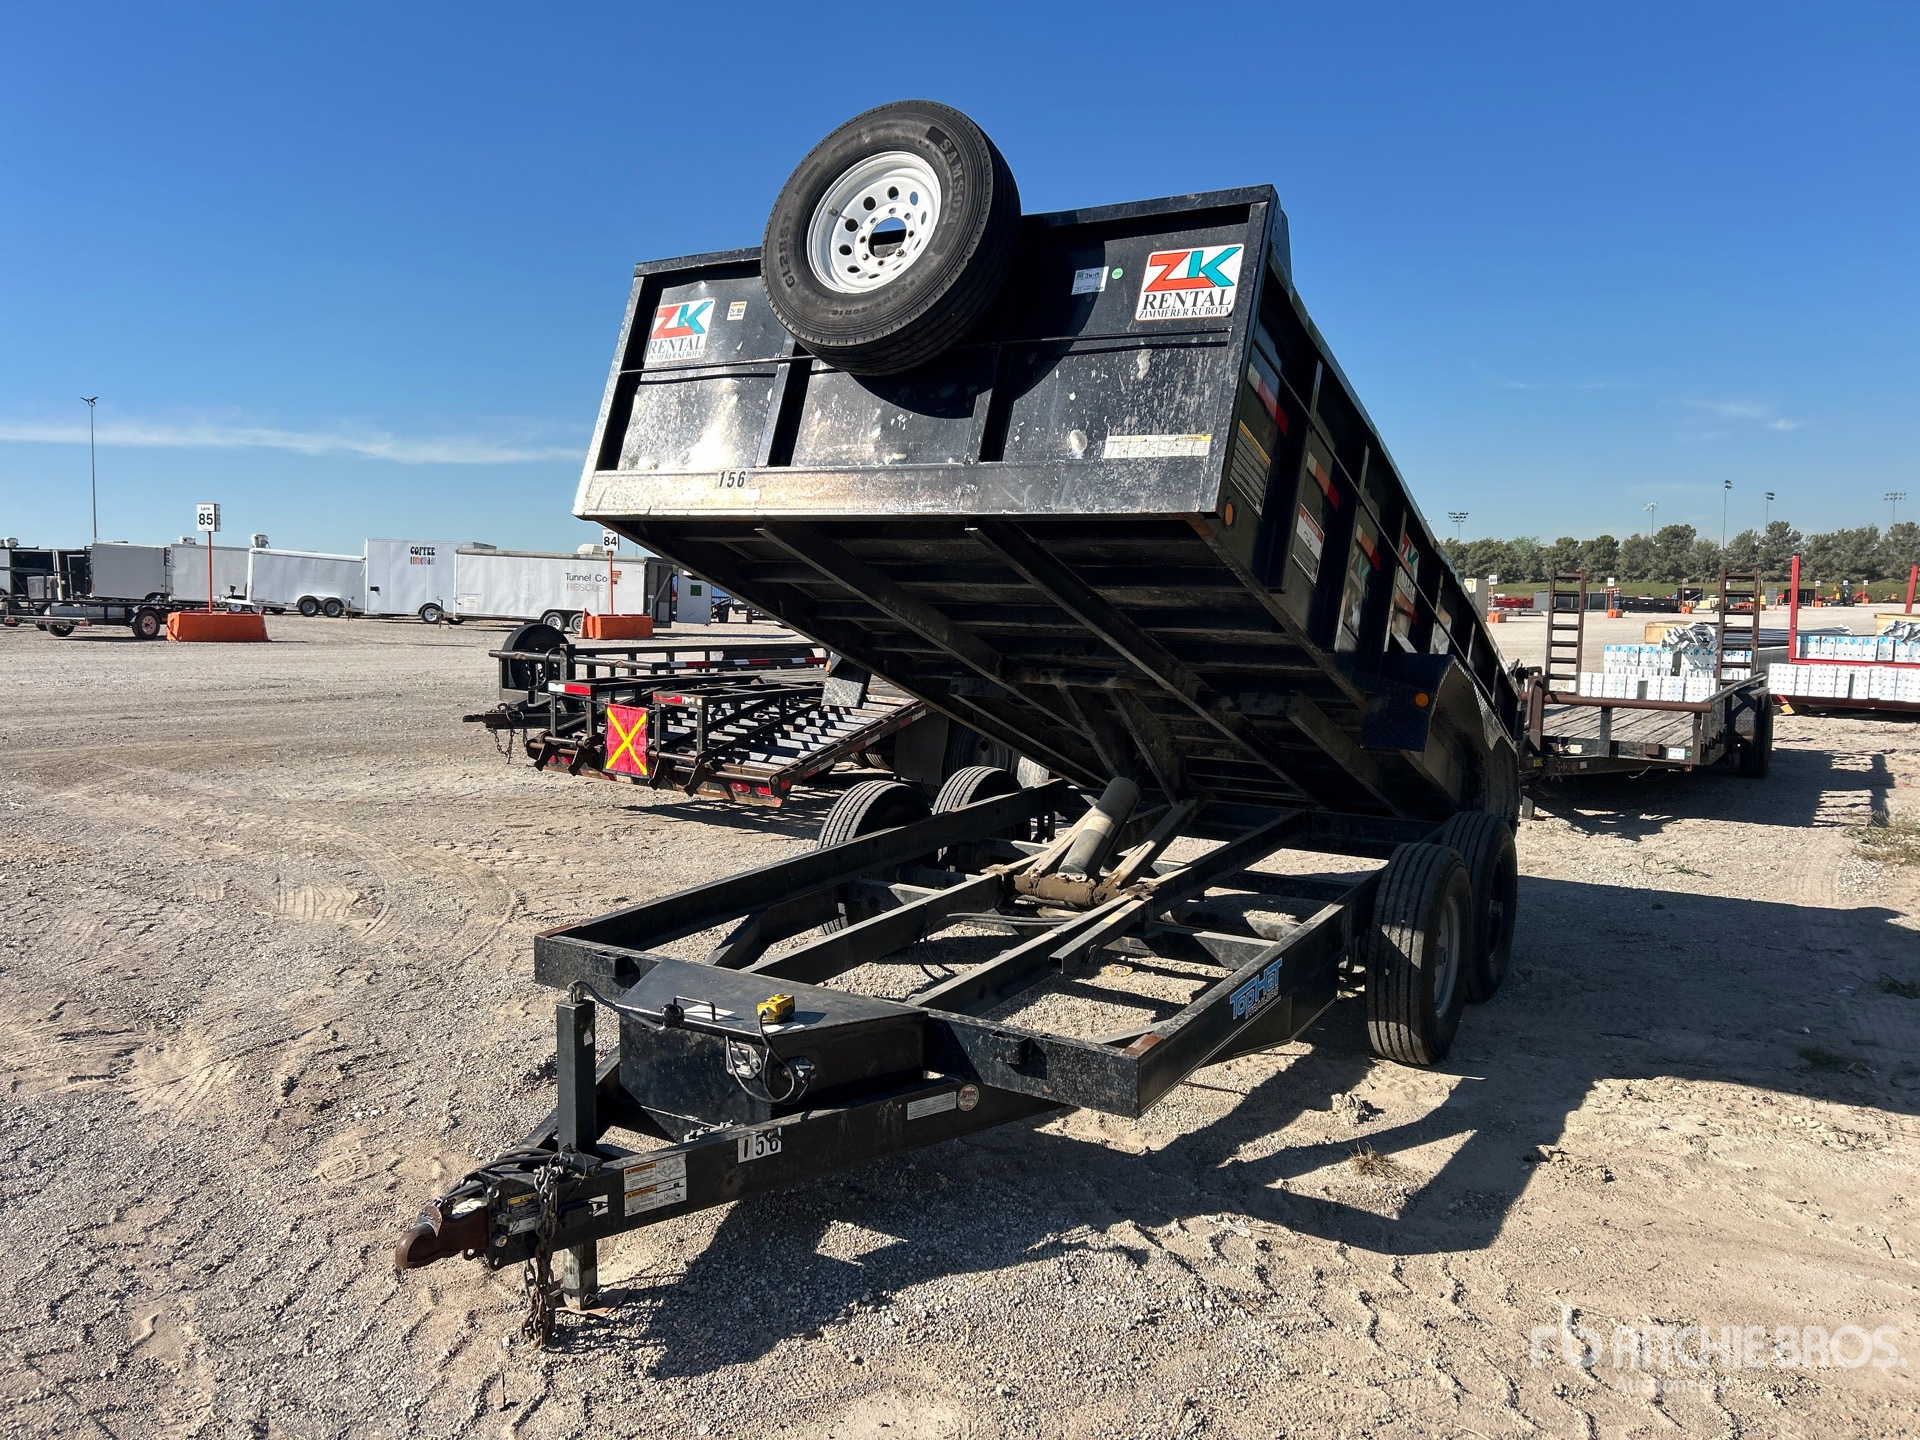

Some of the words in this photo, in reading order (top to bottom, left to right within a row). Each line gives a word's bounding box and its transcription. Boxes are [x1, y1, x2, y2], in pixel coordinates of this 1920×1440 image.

[940, 138, 964, 222] SAMSON
[1144, 246, 1242, 293] ZK
[1142, 289, 1232, 310] RENTAL
[1139, 308, 1189, 319] ZIMMERER
[1191, 305, 1229, 316] KUBOTA
[652, 301, 714, 339] ZK
[648, 335, 703, 355] RENTAL
[719, 471, 746, 488] 156
[198, 513, 213, 525] 85
[603, 536, 617, 546] 84
[410, 546, 436, 556] COFFEE
[565, 573, 592, 582] Tunnel
[566, 583, 605, 592] RESCUE
